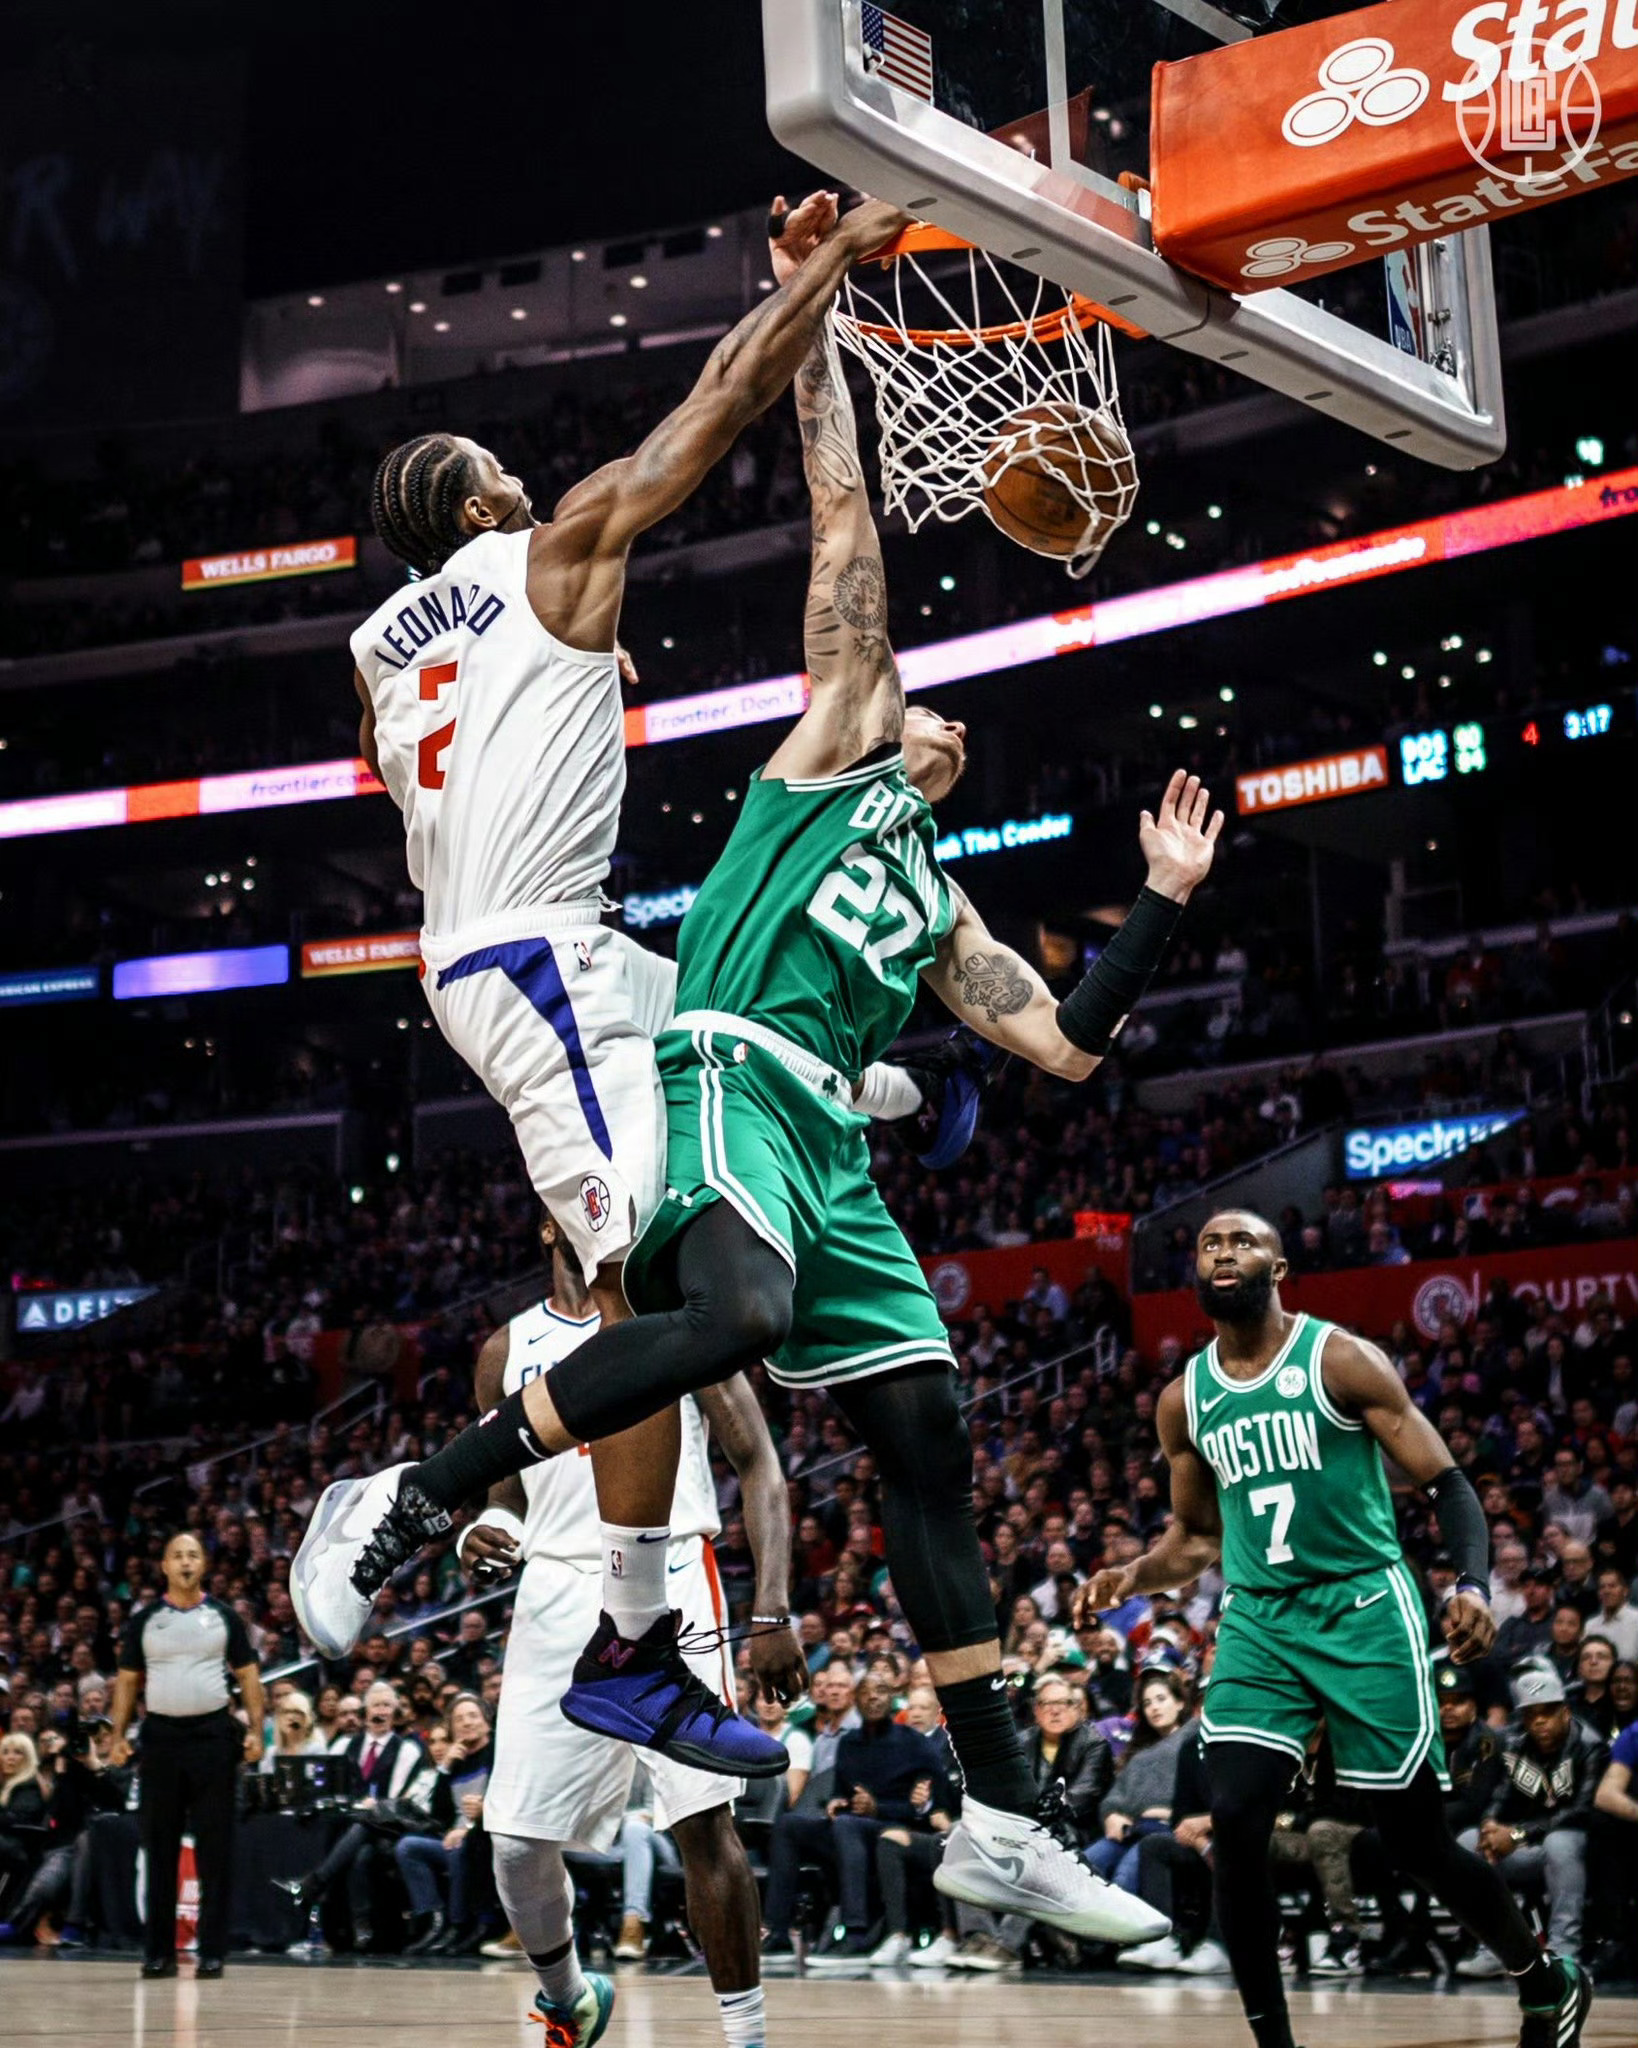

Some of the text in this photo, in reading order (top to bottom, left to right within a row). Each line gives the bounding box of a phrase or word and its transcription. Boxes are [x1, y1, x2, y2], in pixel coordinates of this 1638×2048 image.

[201, 541, 338, 579] WELLS FARGO
[418, 660, 458, 790] 2
[1522, 721, 1540, 745] 4
[1240, 751, 1385, 809] TOSHIBA
[806, 842, 926, 990] 27
[310, 944, 366, 966] WELLS
[1201, 1410, 1323, 1490] BOSTON
[1248, 1482, 1296, 1566] 7
